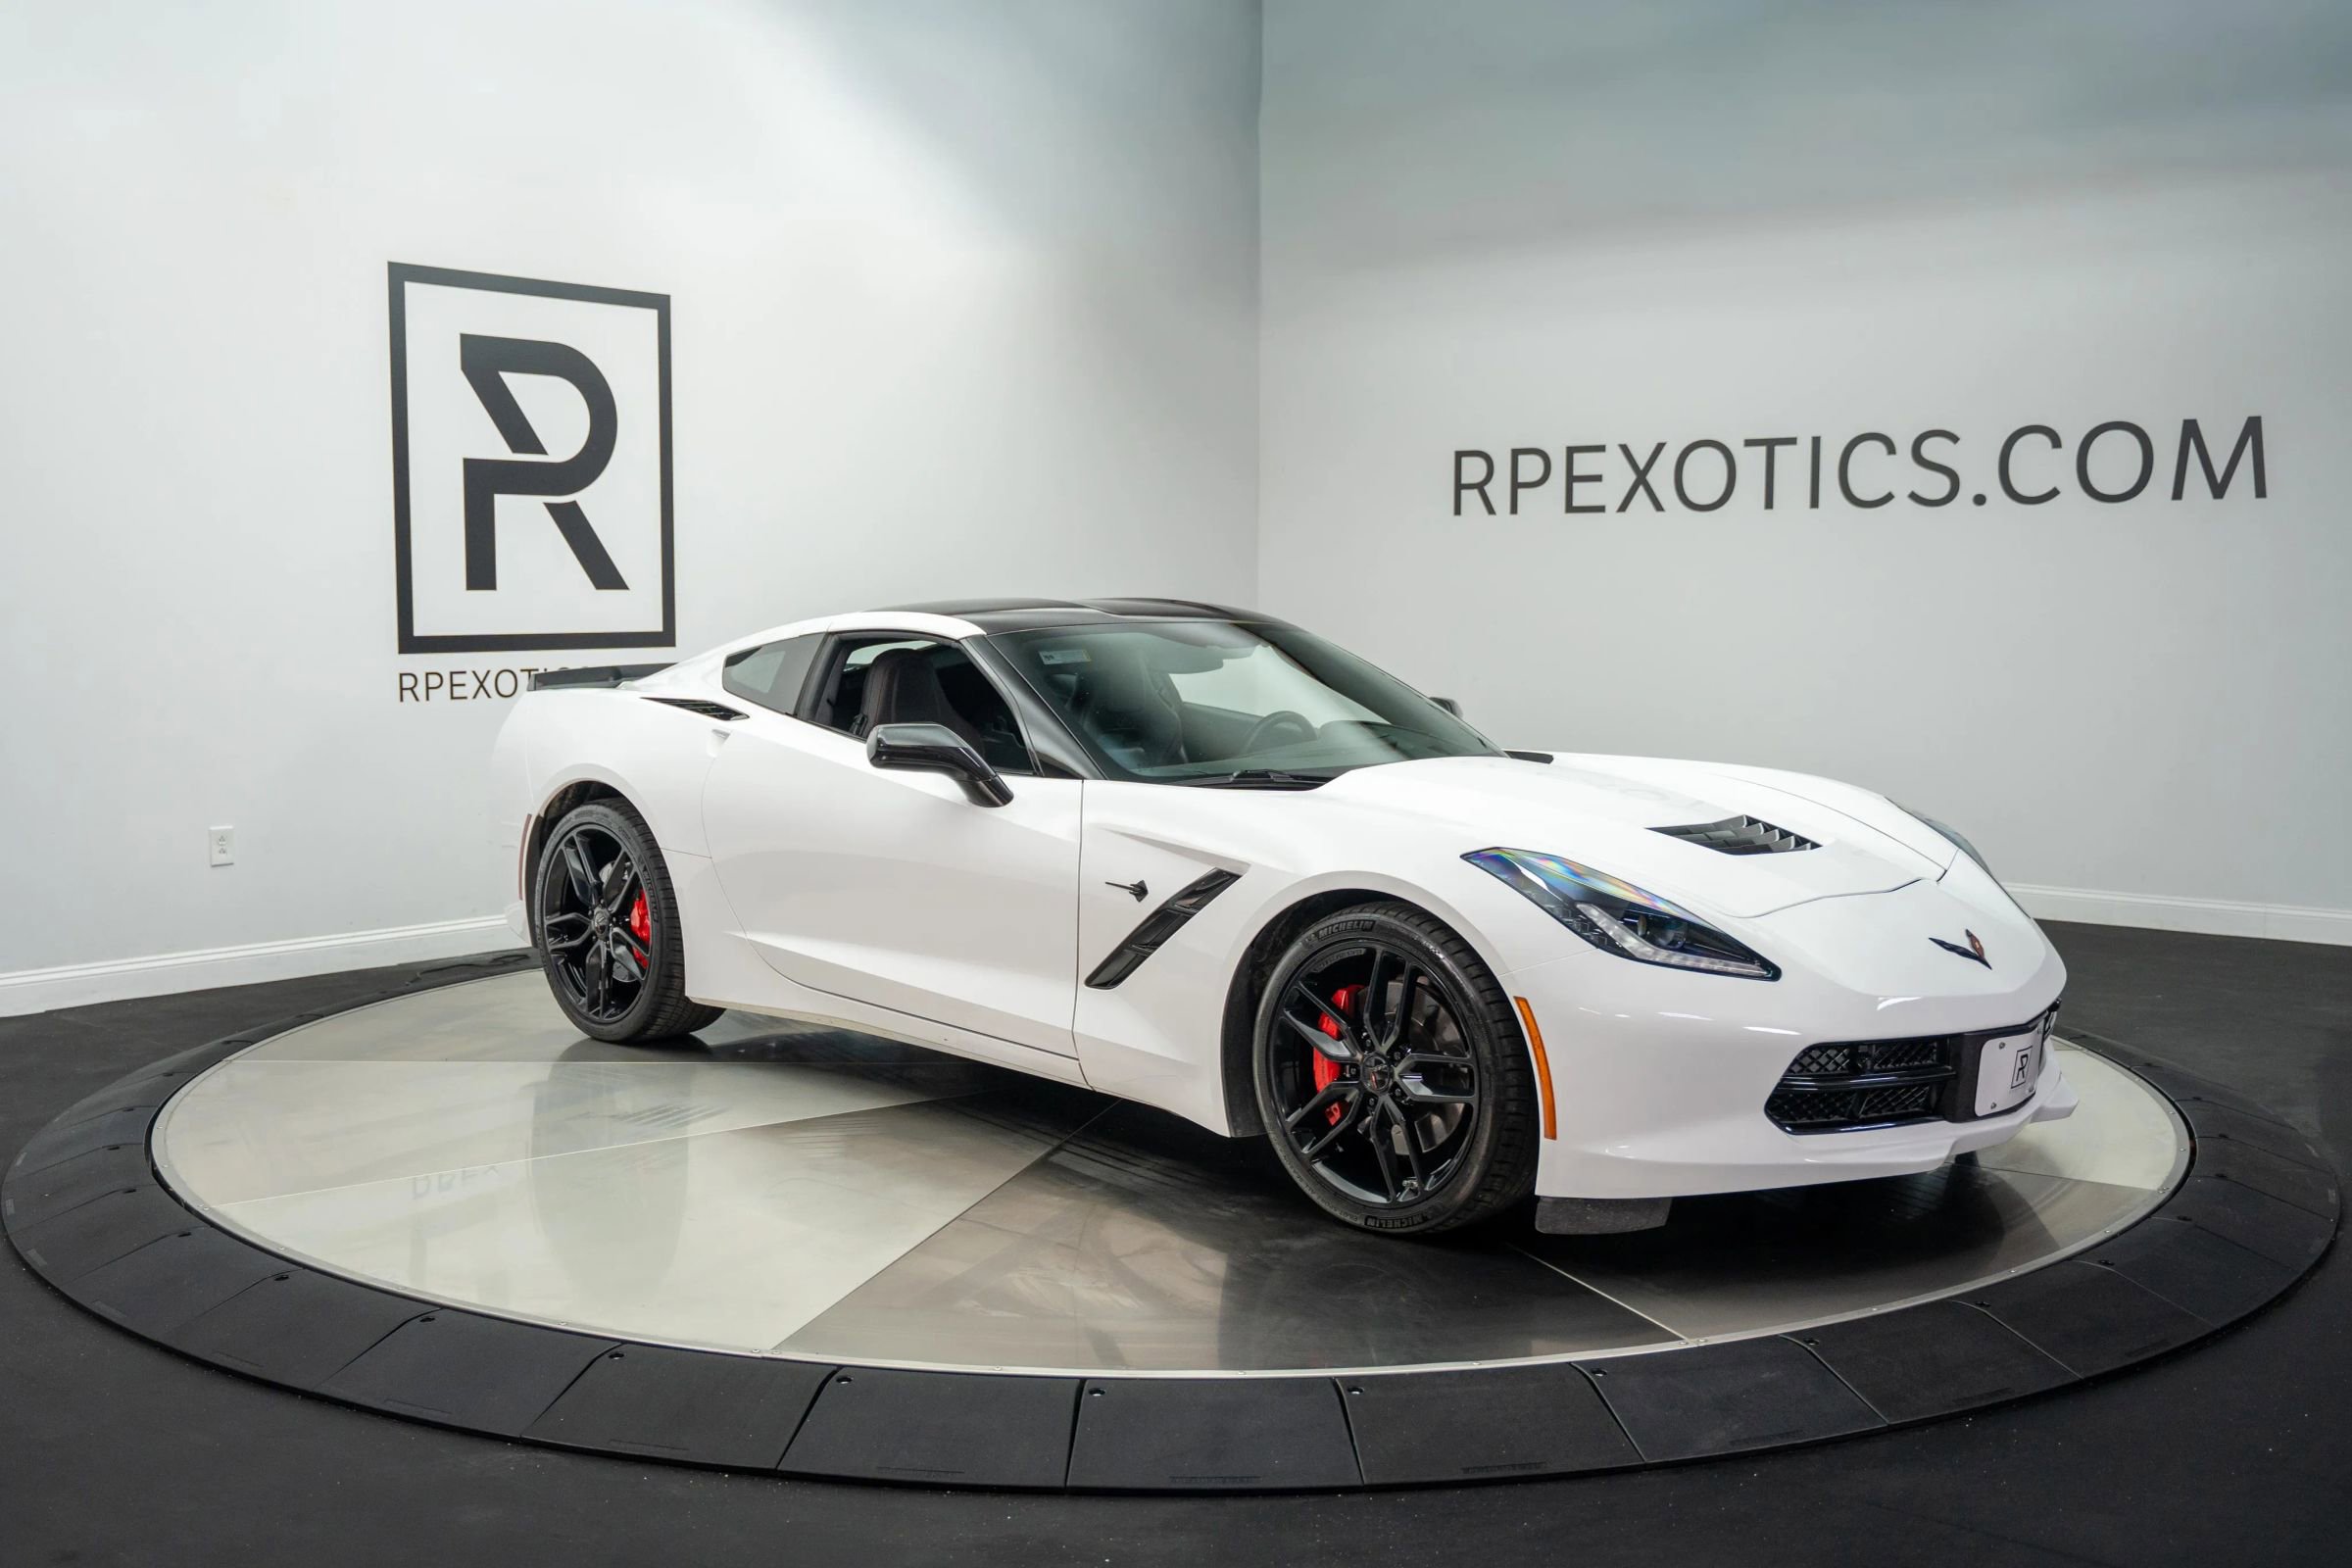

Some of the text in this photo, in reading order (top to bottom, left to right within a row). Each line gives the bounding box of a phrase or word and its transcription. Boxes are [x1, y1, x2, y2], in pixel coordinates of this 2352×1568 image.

[460, 333, 630, 591] R
[1453, 416, 2268, 516] RPEXOTICS.COM
[398, 666, 590, 703] RPEXOT
[1317, 920, 1375, 939] MICHELIN
[1366, 1213, 1423, 1229] MICHELIN
